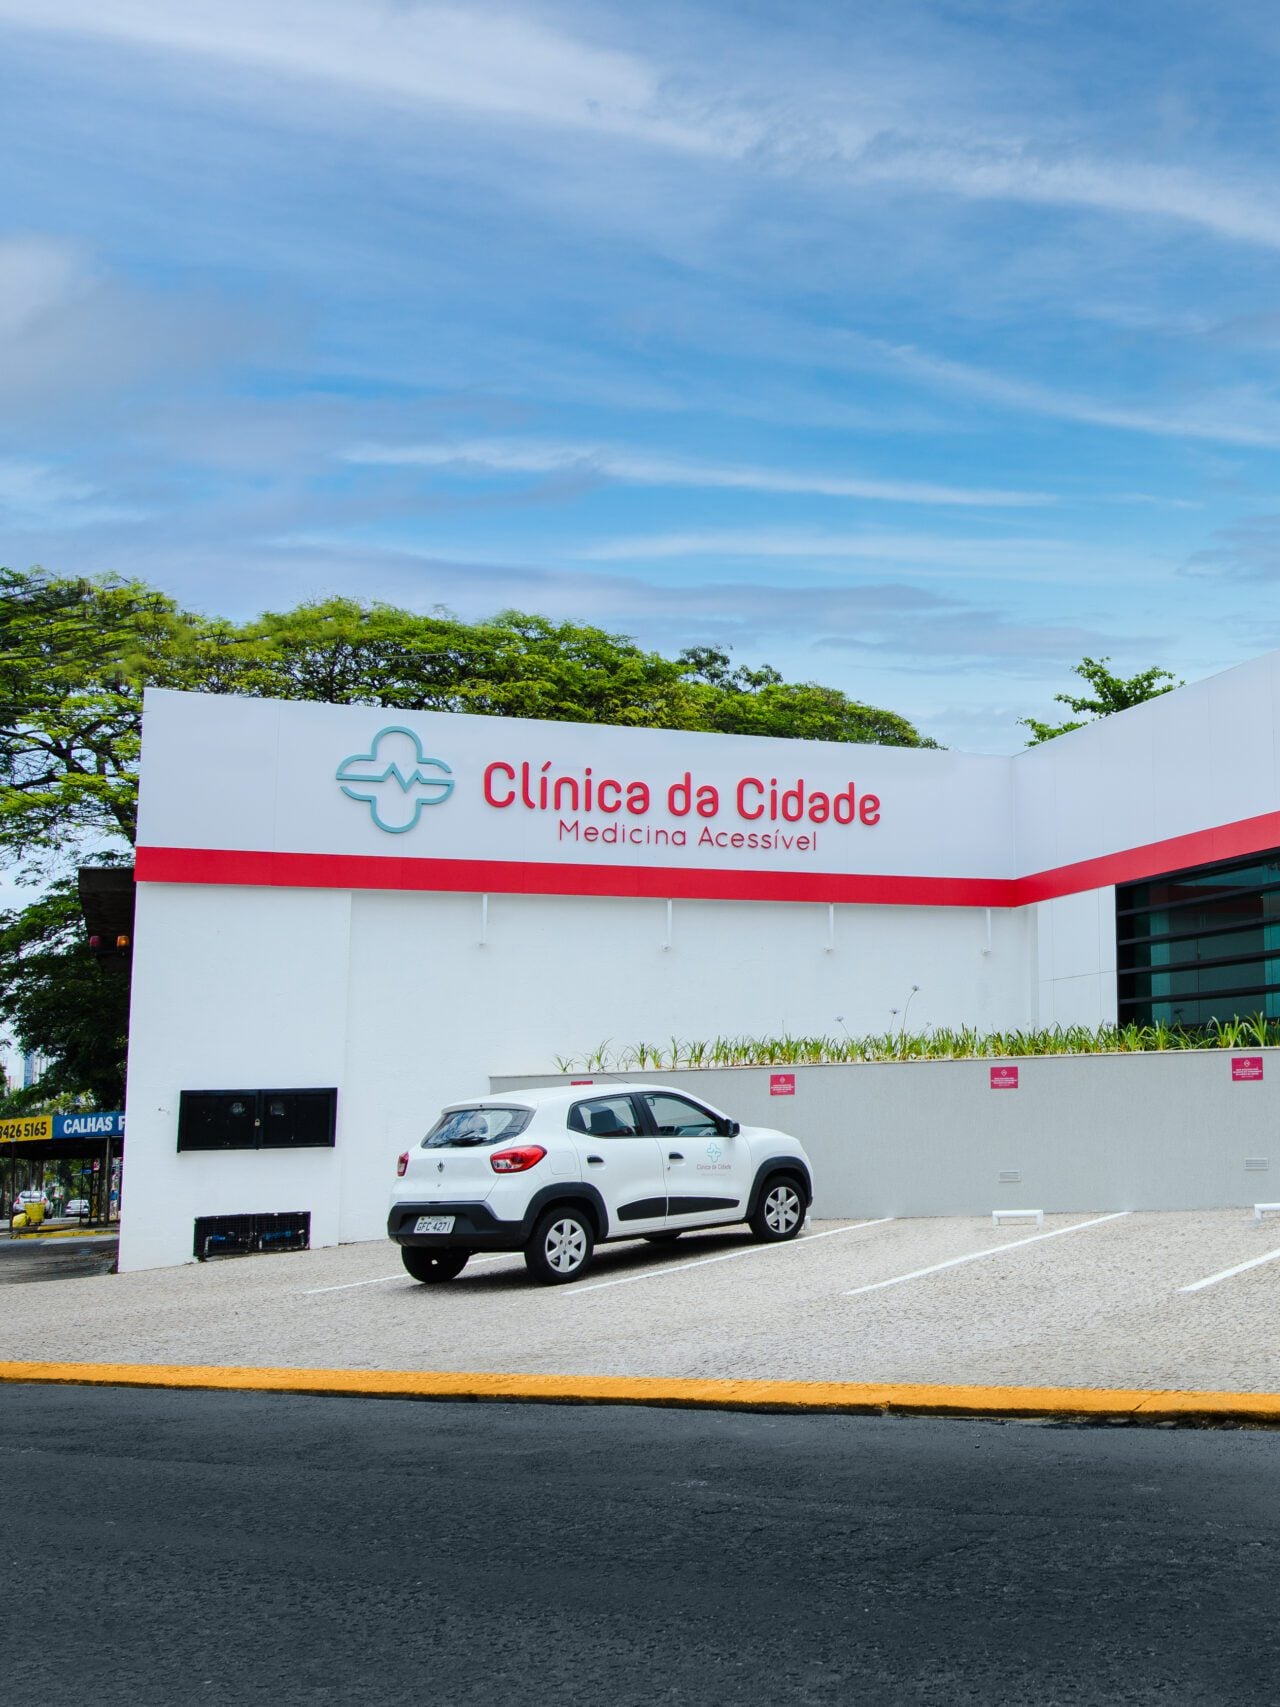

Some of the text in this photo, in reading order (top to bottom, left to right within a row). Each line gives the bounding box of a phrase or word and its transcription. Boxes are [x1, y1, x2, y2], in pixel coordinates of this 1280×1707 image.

[483, 761, 881, 826] Clínica da Cidade
[558, 819, 817, 851] Medicina Acessível
[24, 1121, 47, 1138] 5165
[64, 1116, 113, 1134] CALHAS
